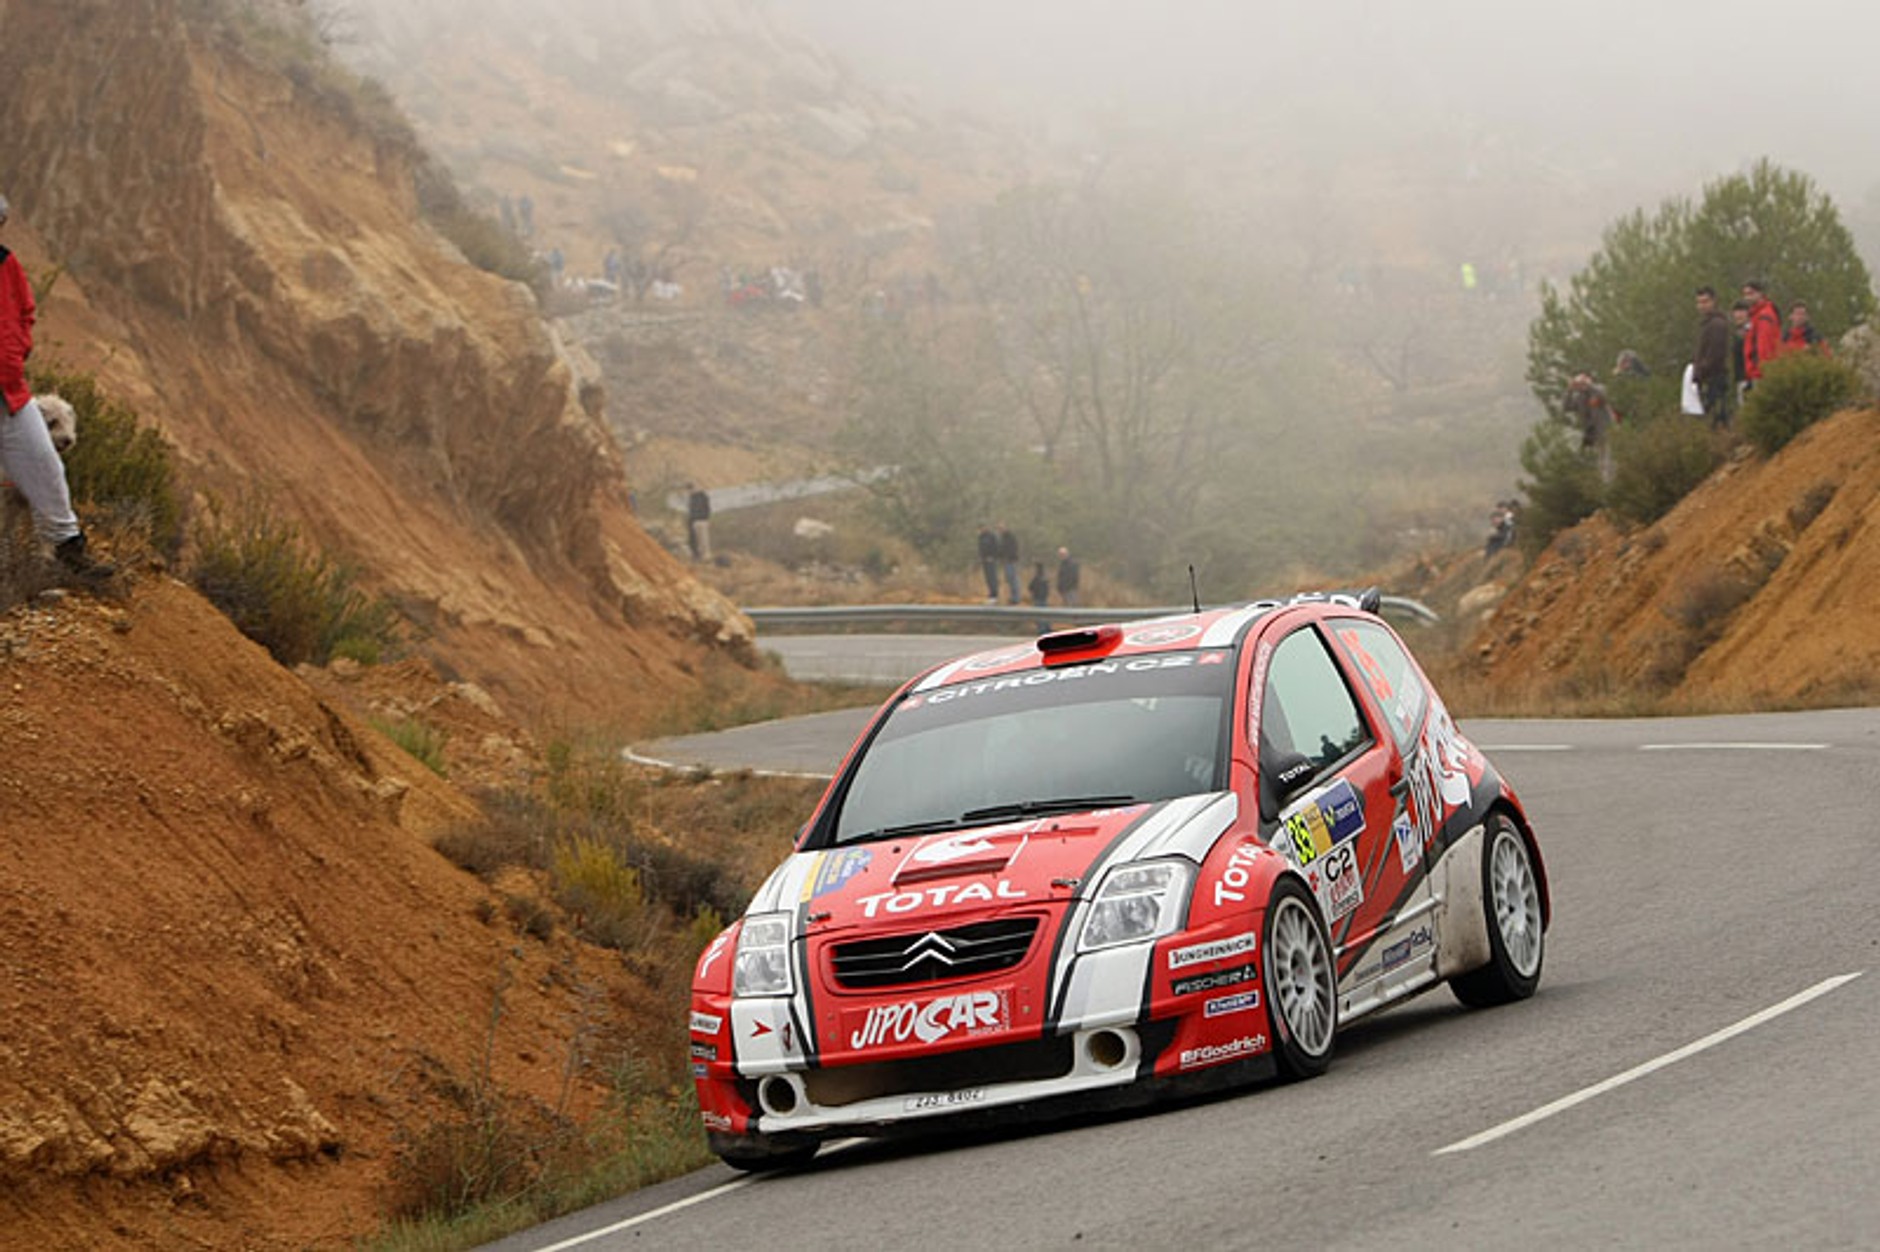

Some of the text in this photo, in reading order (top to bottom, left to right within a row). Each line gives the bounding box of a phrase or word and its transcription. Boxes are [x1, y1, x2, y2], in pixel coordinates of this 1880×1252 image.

[1126, 655, 1194, 672] C2
[1278, 763, 1311, 783] TOTAL
[1286, 814, 1316, 864] 35
[1214, 843, 1264, 906] TOTA
[1325, 847, 1353, 882] C2
[855, 880, 1027, 917] TOTAL
[850, 991, 1000, 1049] JIPOCAR
[1180, 1033, 1266, 1064] BFGoodrich
